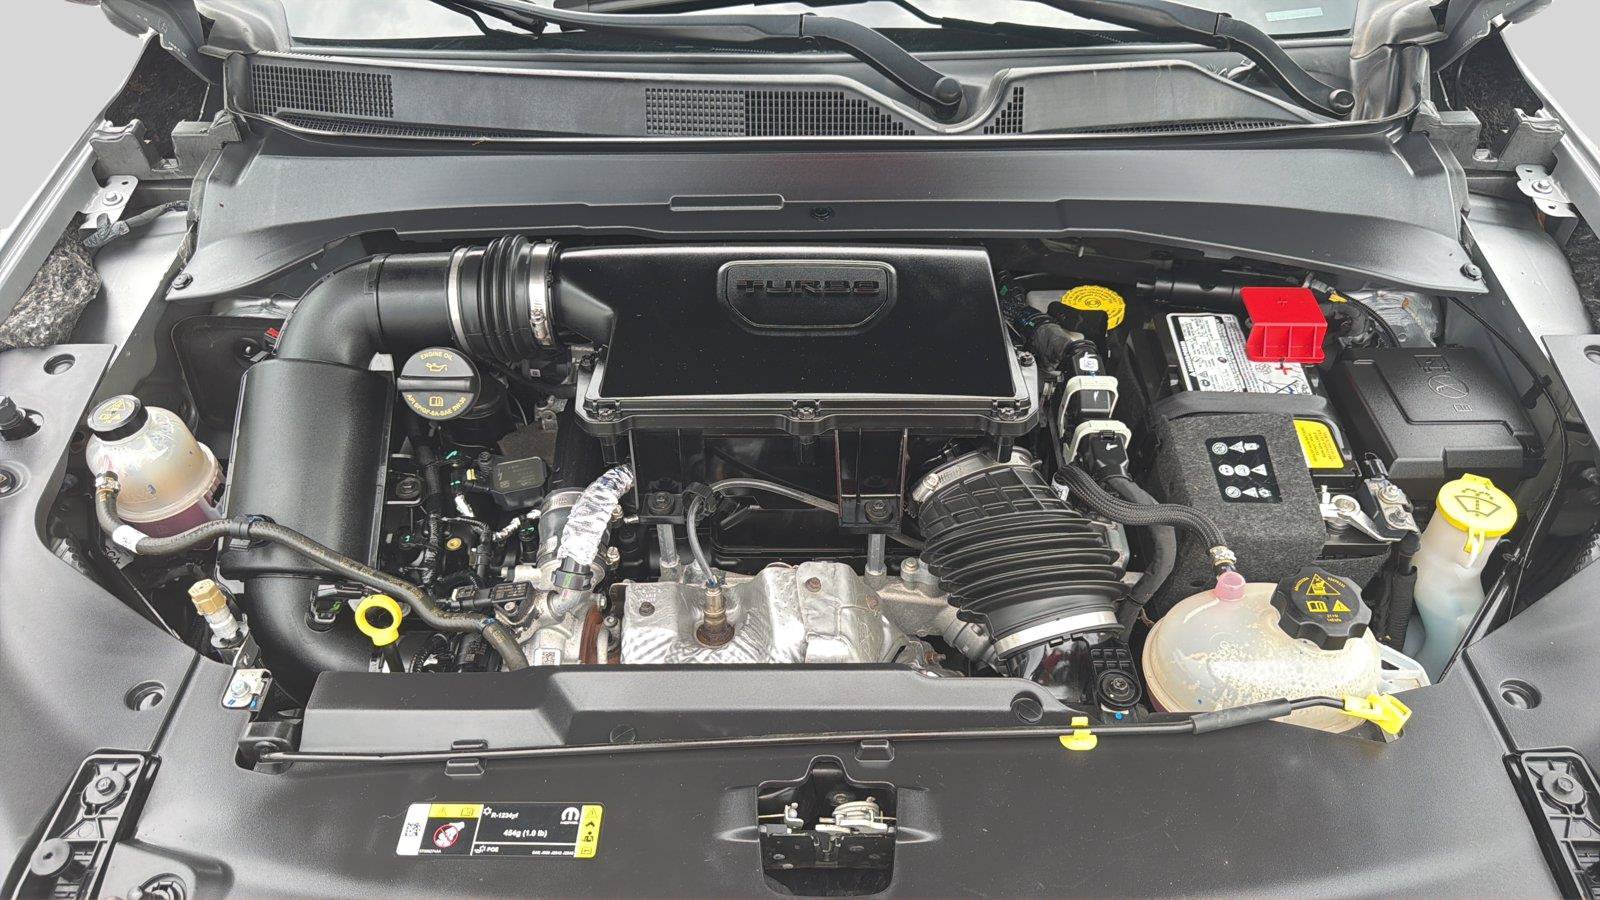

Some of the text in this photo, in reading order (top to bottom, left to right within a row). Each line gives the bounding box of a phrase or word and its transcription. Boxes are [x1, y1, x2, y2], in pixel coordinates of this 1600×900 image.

[736, 280, 880, 295] TURBO
[420, 351, 454, 361] ENGINE OIL
[491, 811, 519, 820] R-1234yf
[503, 829, 548, 838] 454g (1.0 lb)
